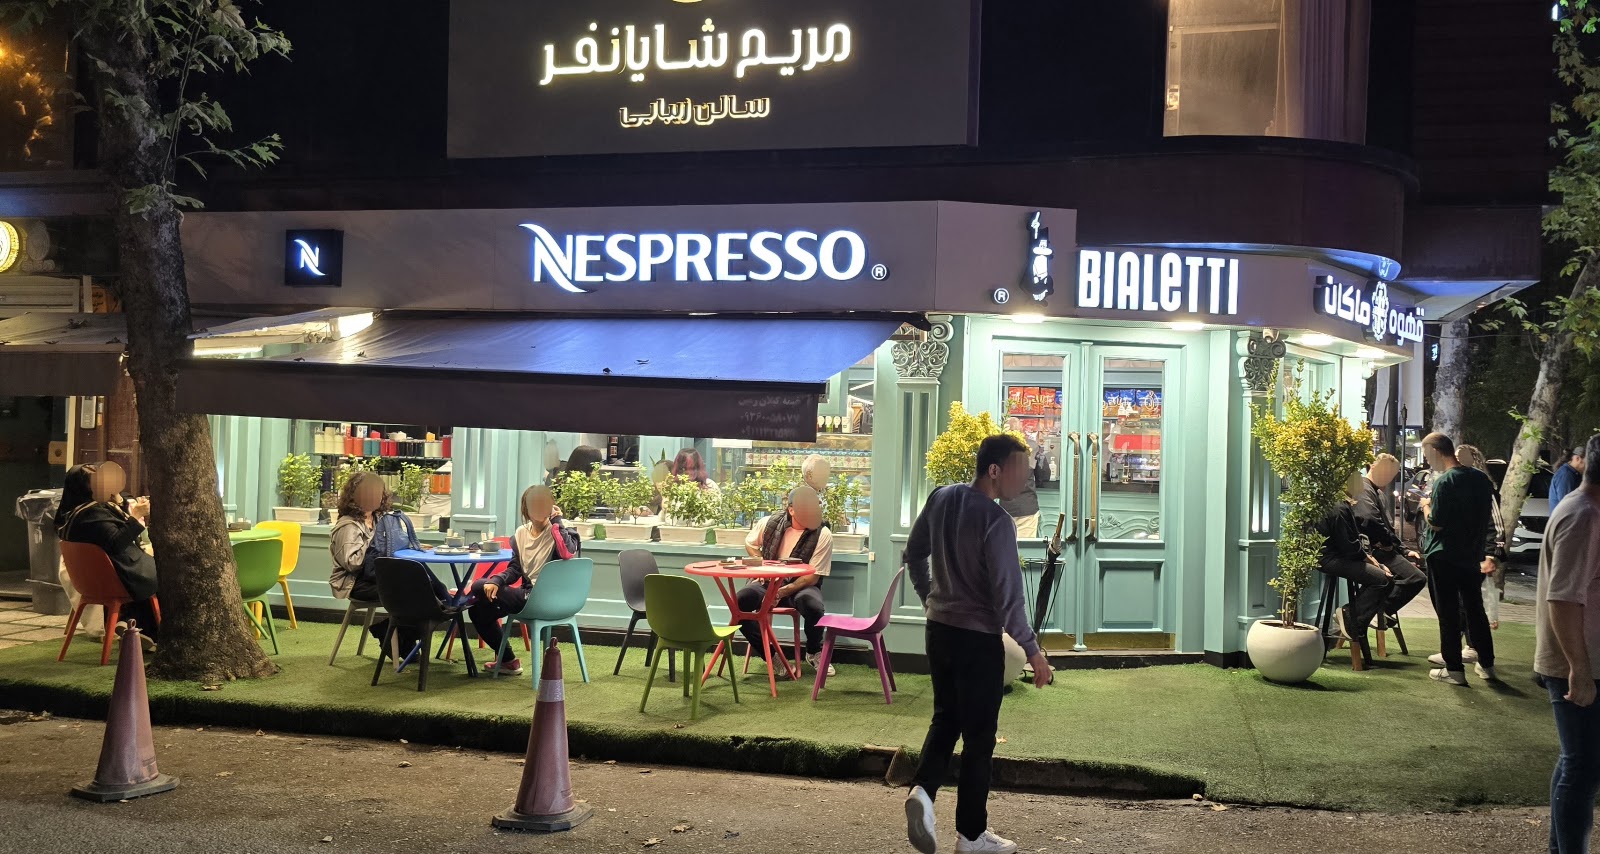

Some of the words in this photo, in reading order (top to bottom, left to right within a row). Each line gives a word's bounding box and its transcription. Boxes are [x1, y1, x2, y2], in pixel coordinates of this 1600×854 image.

[737, 23, 851, 78] مریم
[619, 97, 691, 128] زیبایی
[693, 95, 770, 126] سالن
[517, 223, 866, 293] NESPRESSO
[1324, 274, 1371, 326] ماکان
[1388, 306, 1425, 347] قهوه
